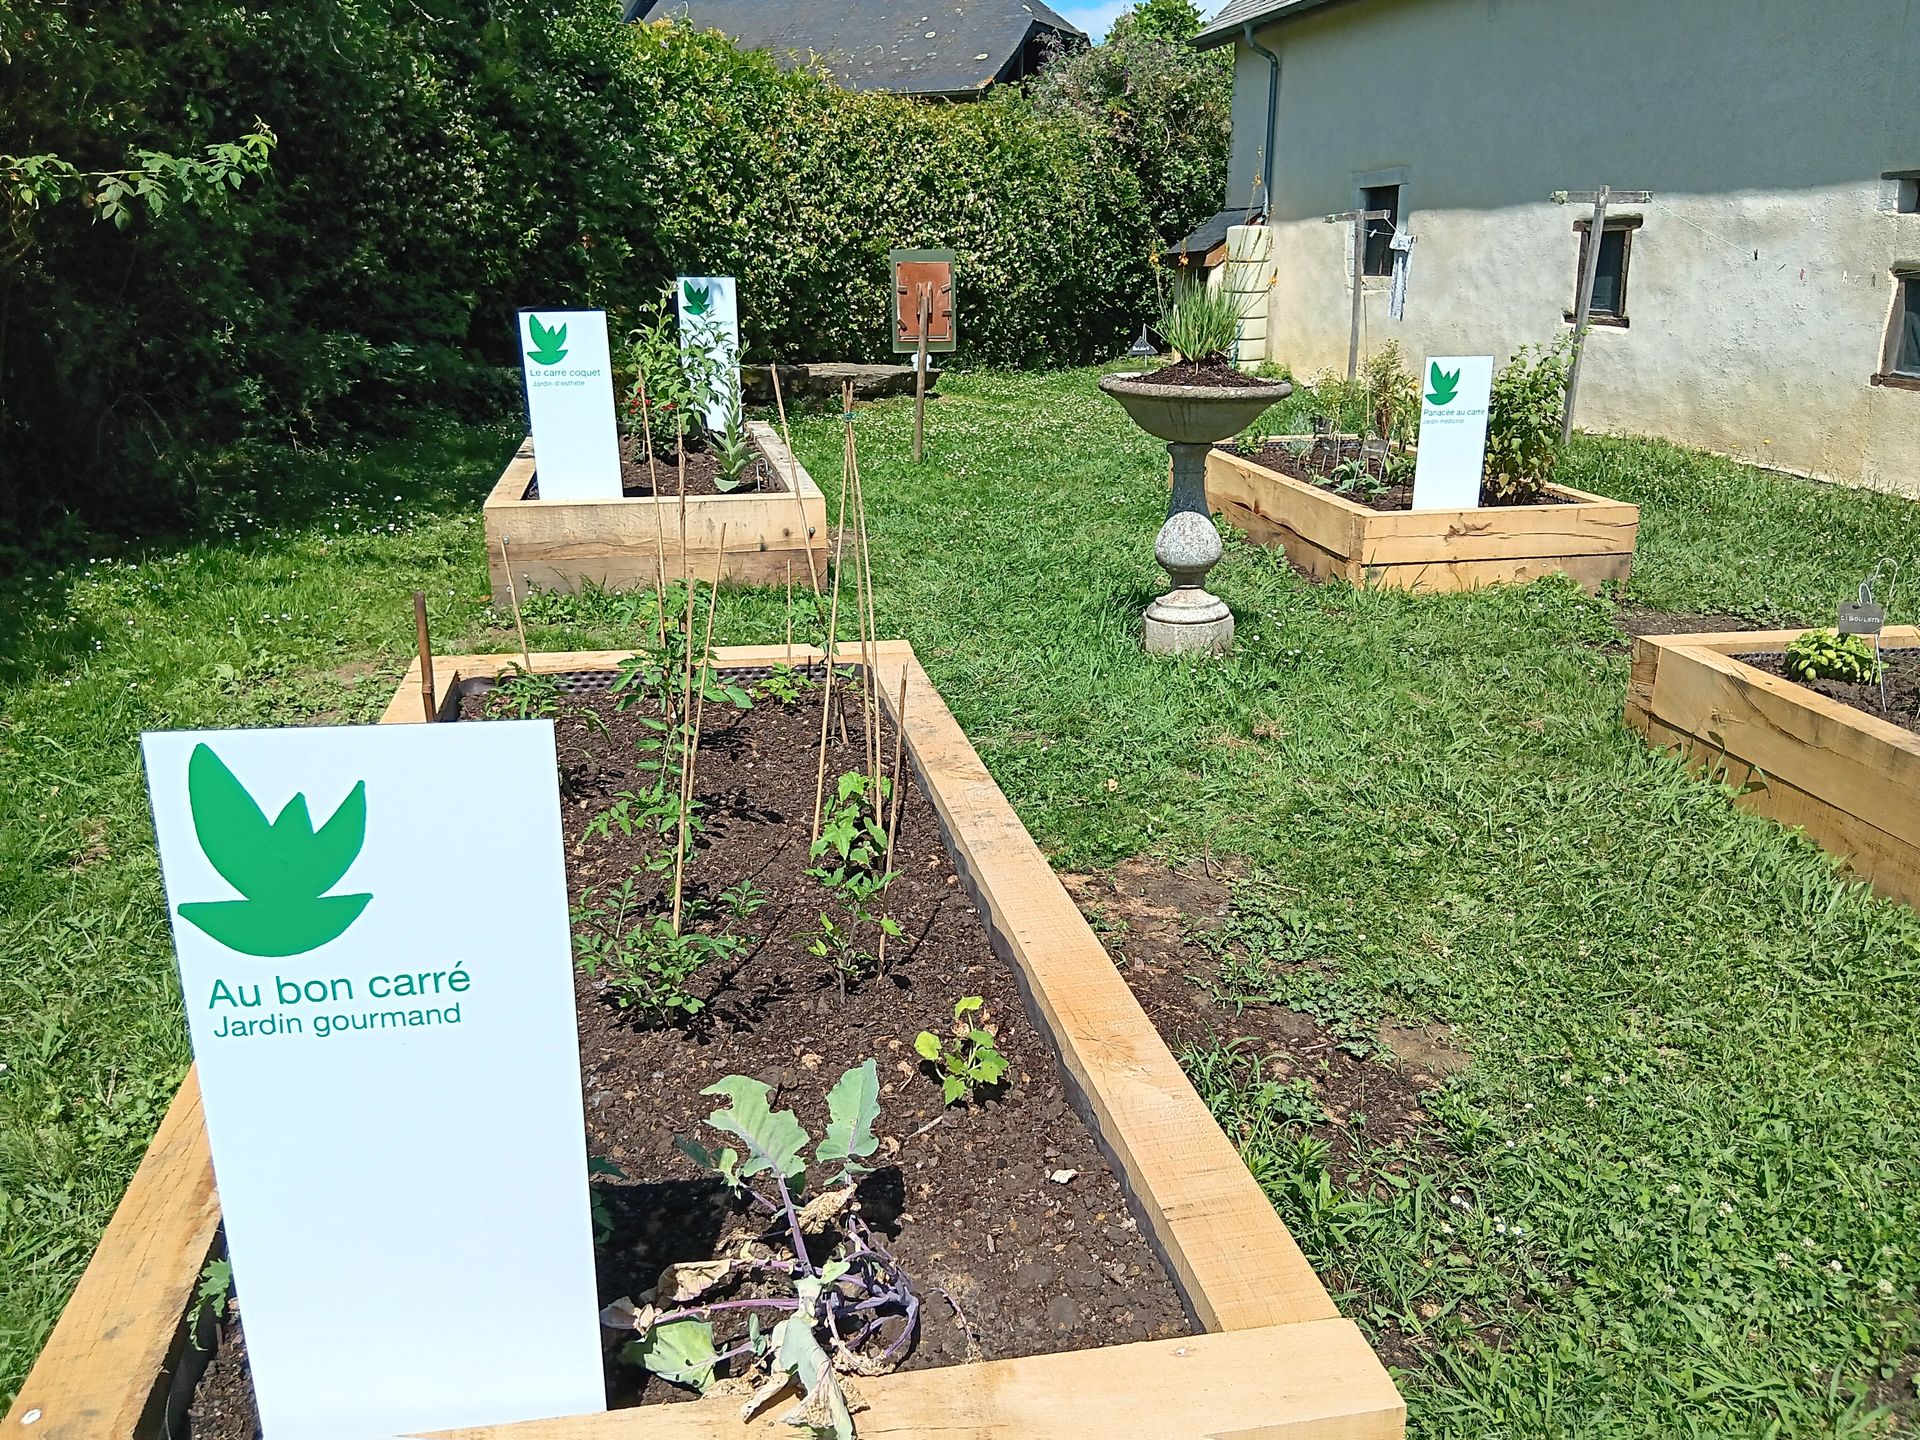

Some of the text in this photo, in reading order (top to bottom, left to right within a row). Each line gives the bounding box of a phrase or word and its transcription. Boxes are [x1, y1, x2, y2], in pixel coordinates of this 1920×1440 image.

[530, 369, 542, 377] Le
[569, 369, 601, 379] coquet
[208, 960, 471, 1010] Au bon carré
[213, 1001, 462, 1038] Jardin gourmand
